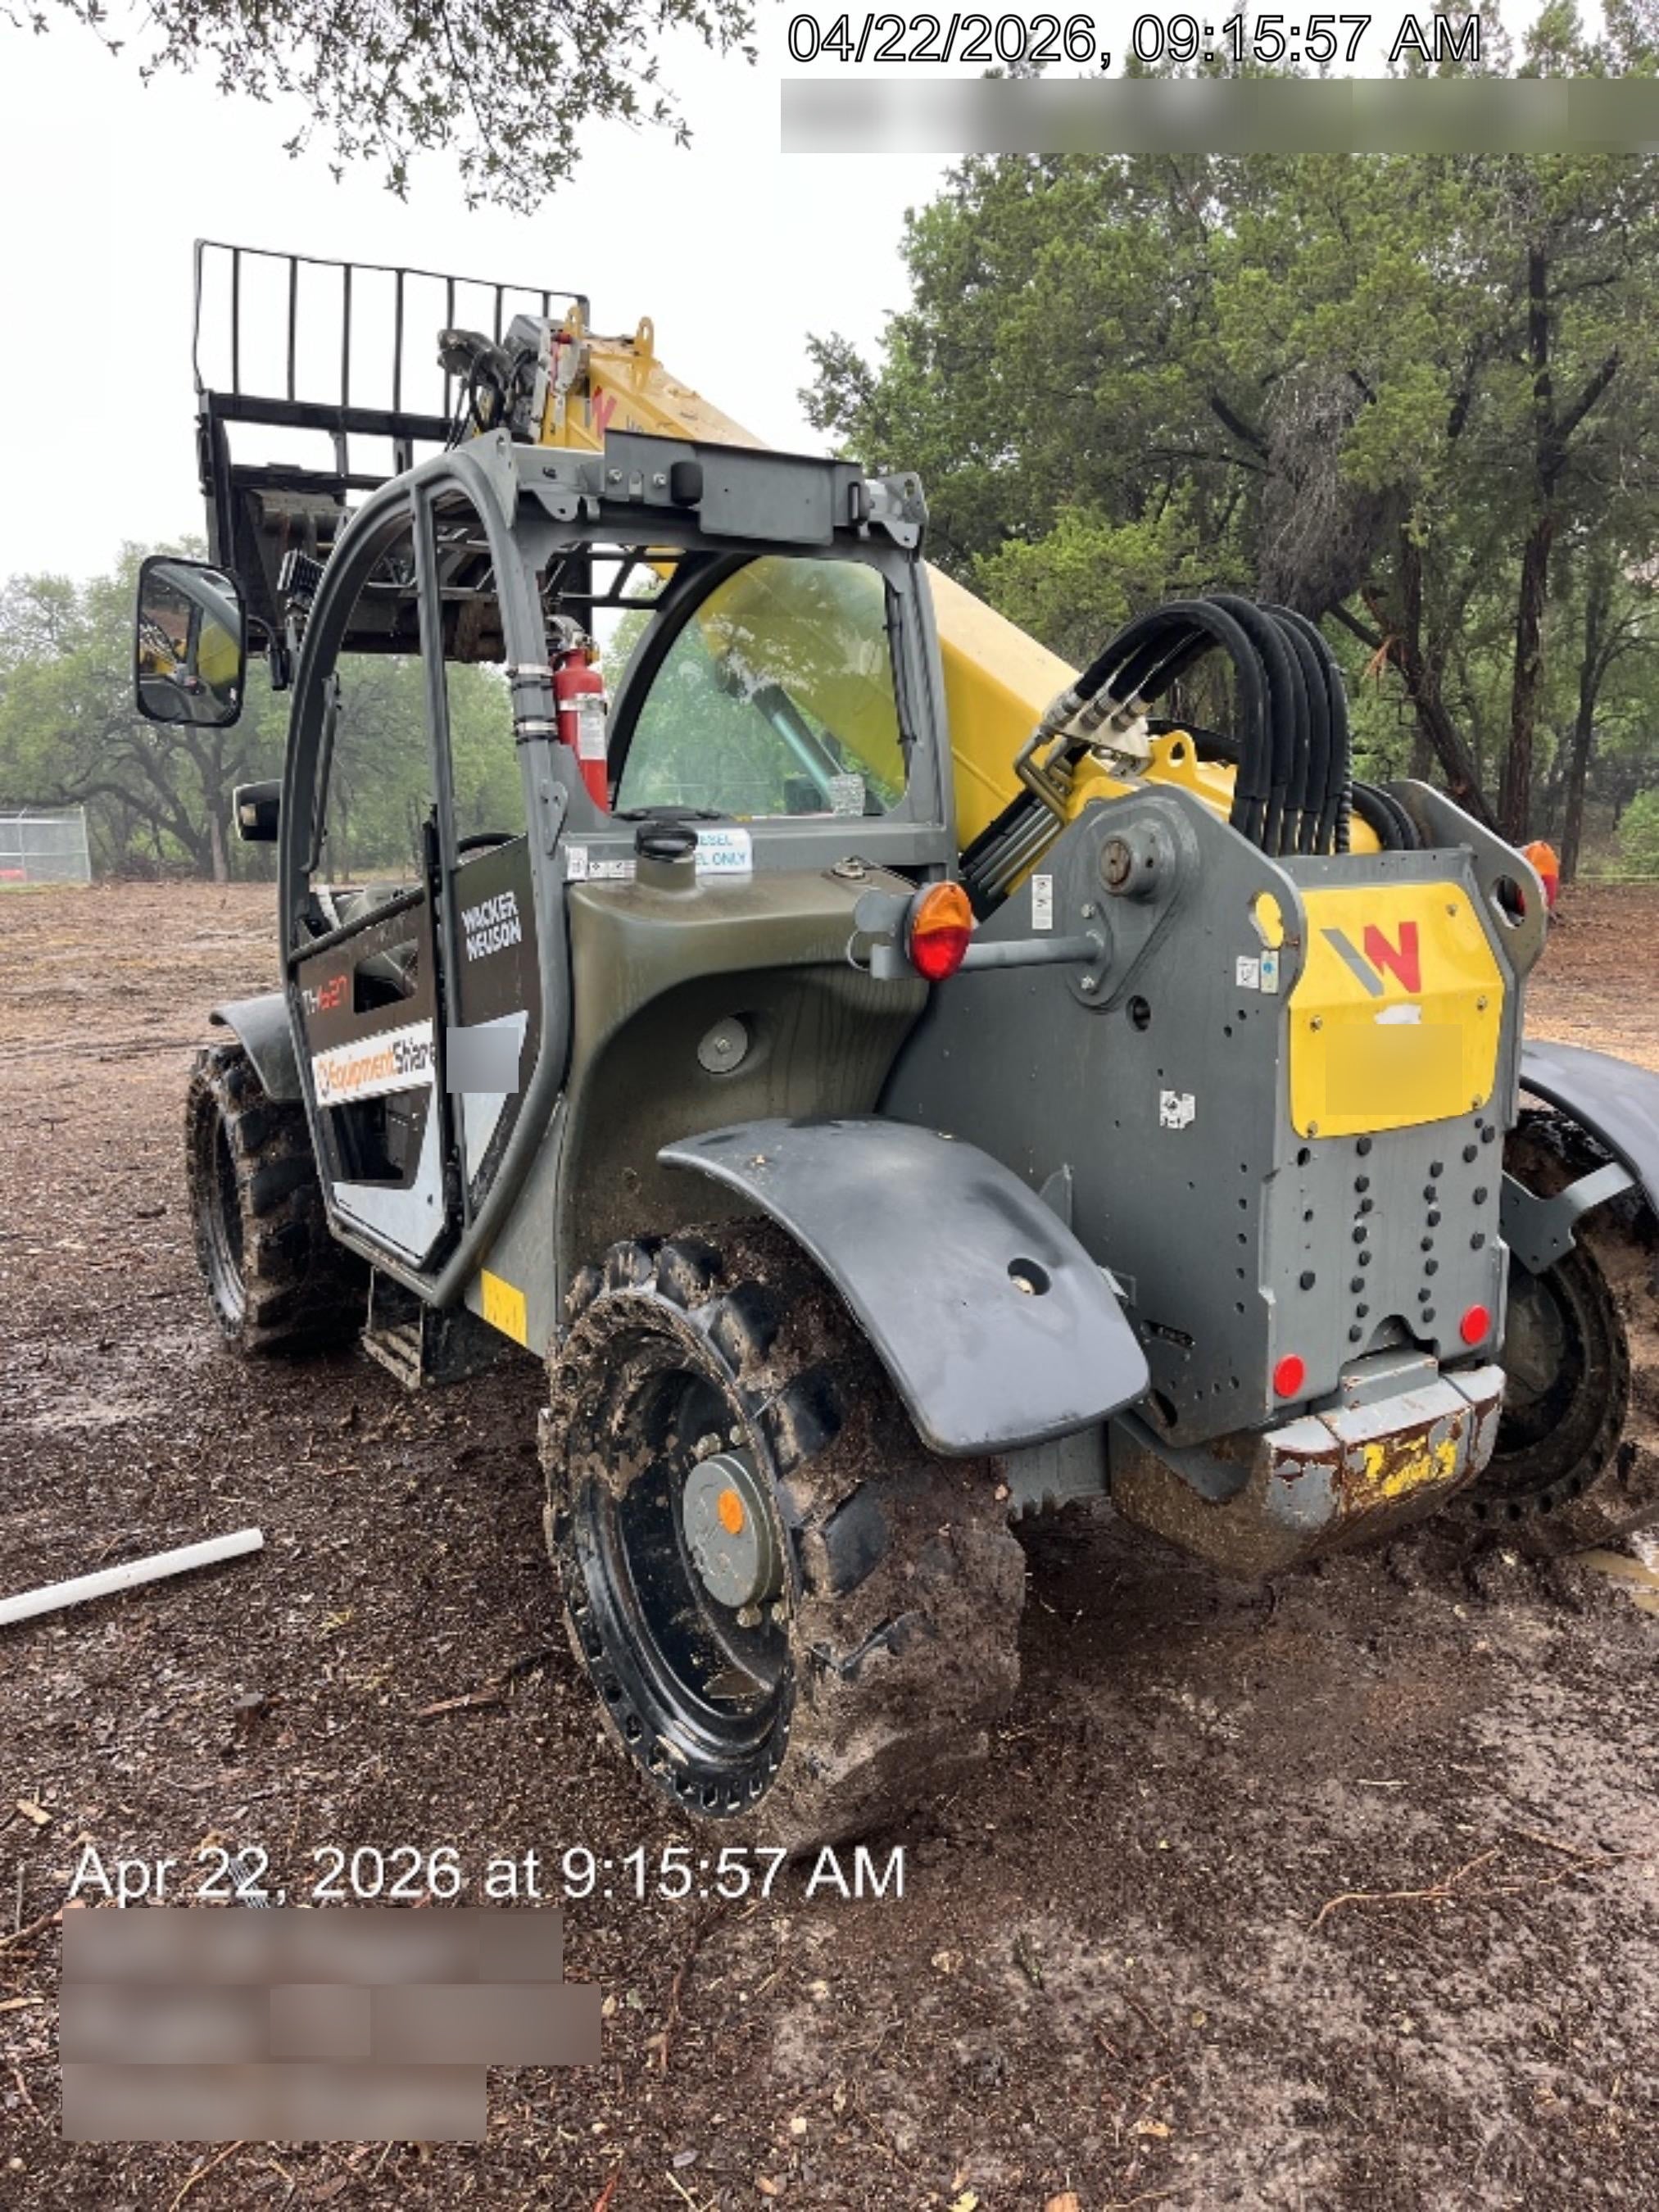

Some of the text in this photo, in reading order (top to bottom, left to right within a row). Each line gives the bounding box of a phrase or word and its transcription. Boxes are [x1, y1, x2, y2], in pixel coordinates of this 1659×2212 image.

[711, 851, 746, 866] ONLY
[461, 891, 519, 935] WACKER
[466, 916, 522, 962] NEUSON
